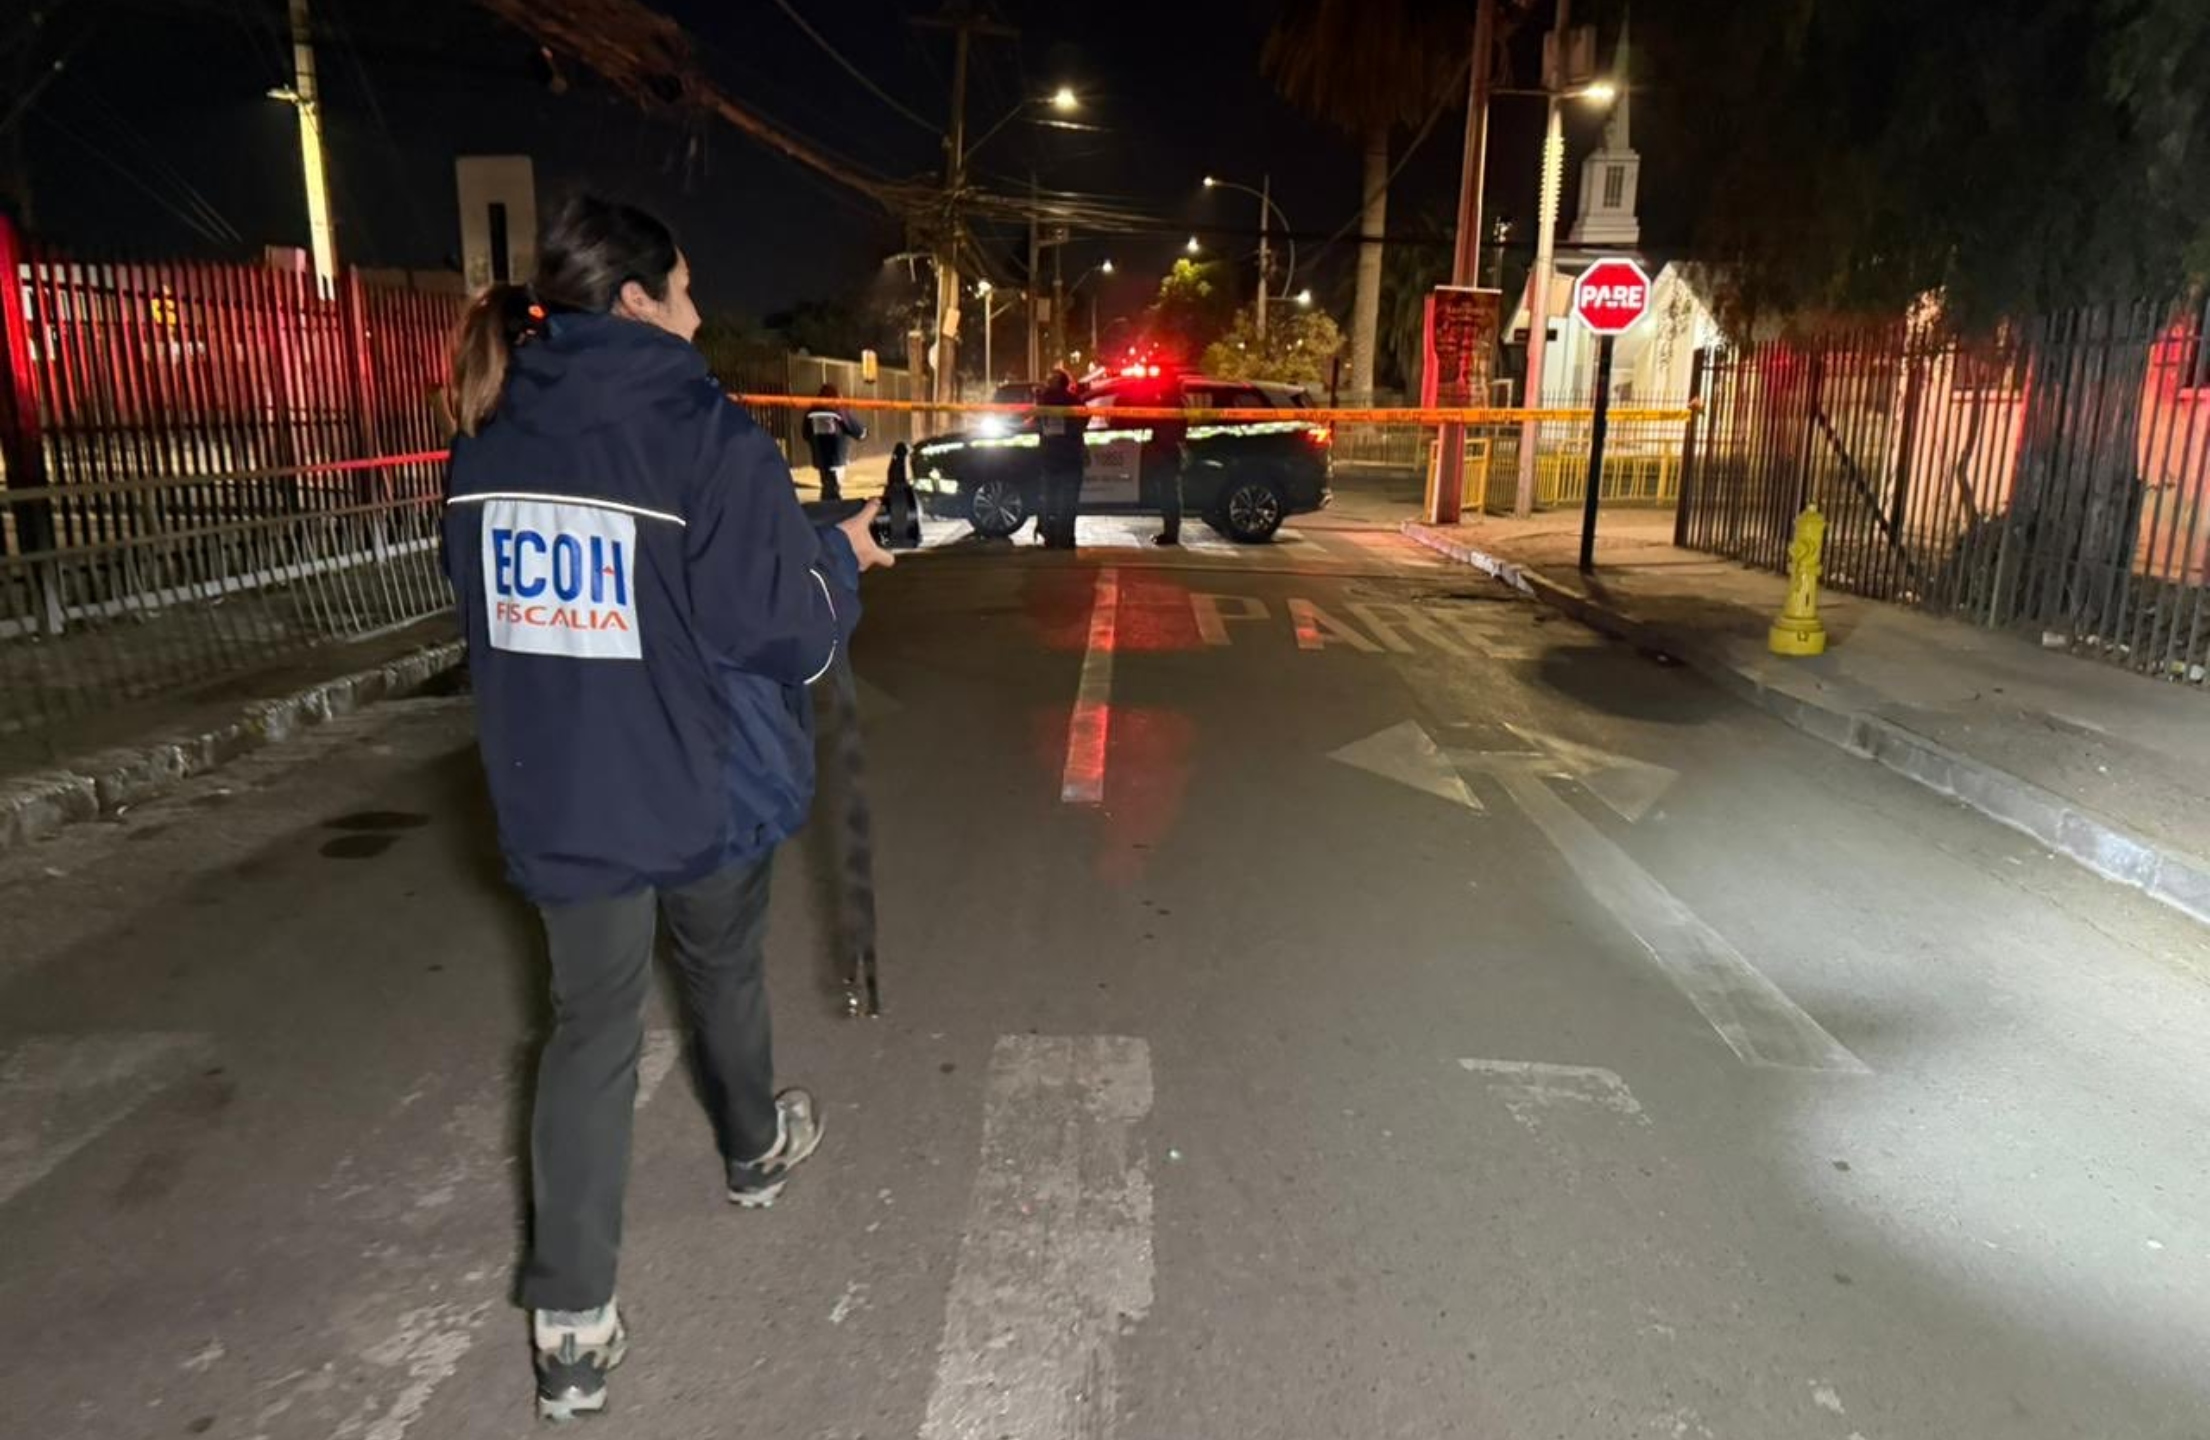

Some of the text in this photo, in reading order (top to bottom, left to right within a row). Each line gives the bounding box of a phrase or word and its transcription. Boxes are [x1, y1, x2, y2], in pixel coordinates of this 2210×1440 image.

[1580, 285, 1643, 309] PARE
[491, 529, 627, 606] ECOH
[496, 602, 629, 631] FISCALIA
[1188, 592, 1538, 659] PARE
